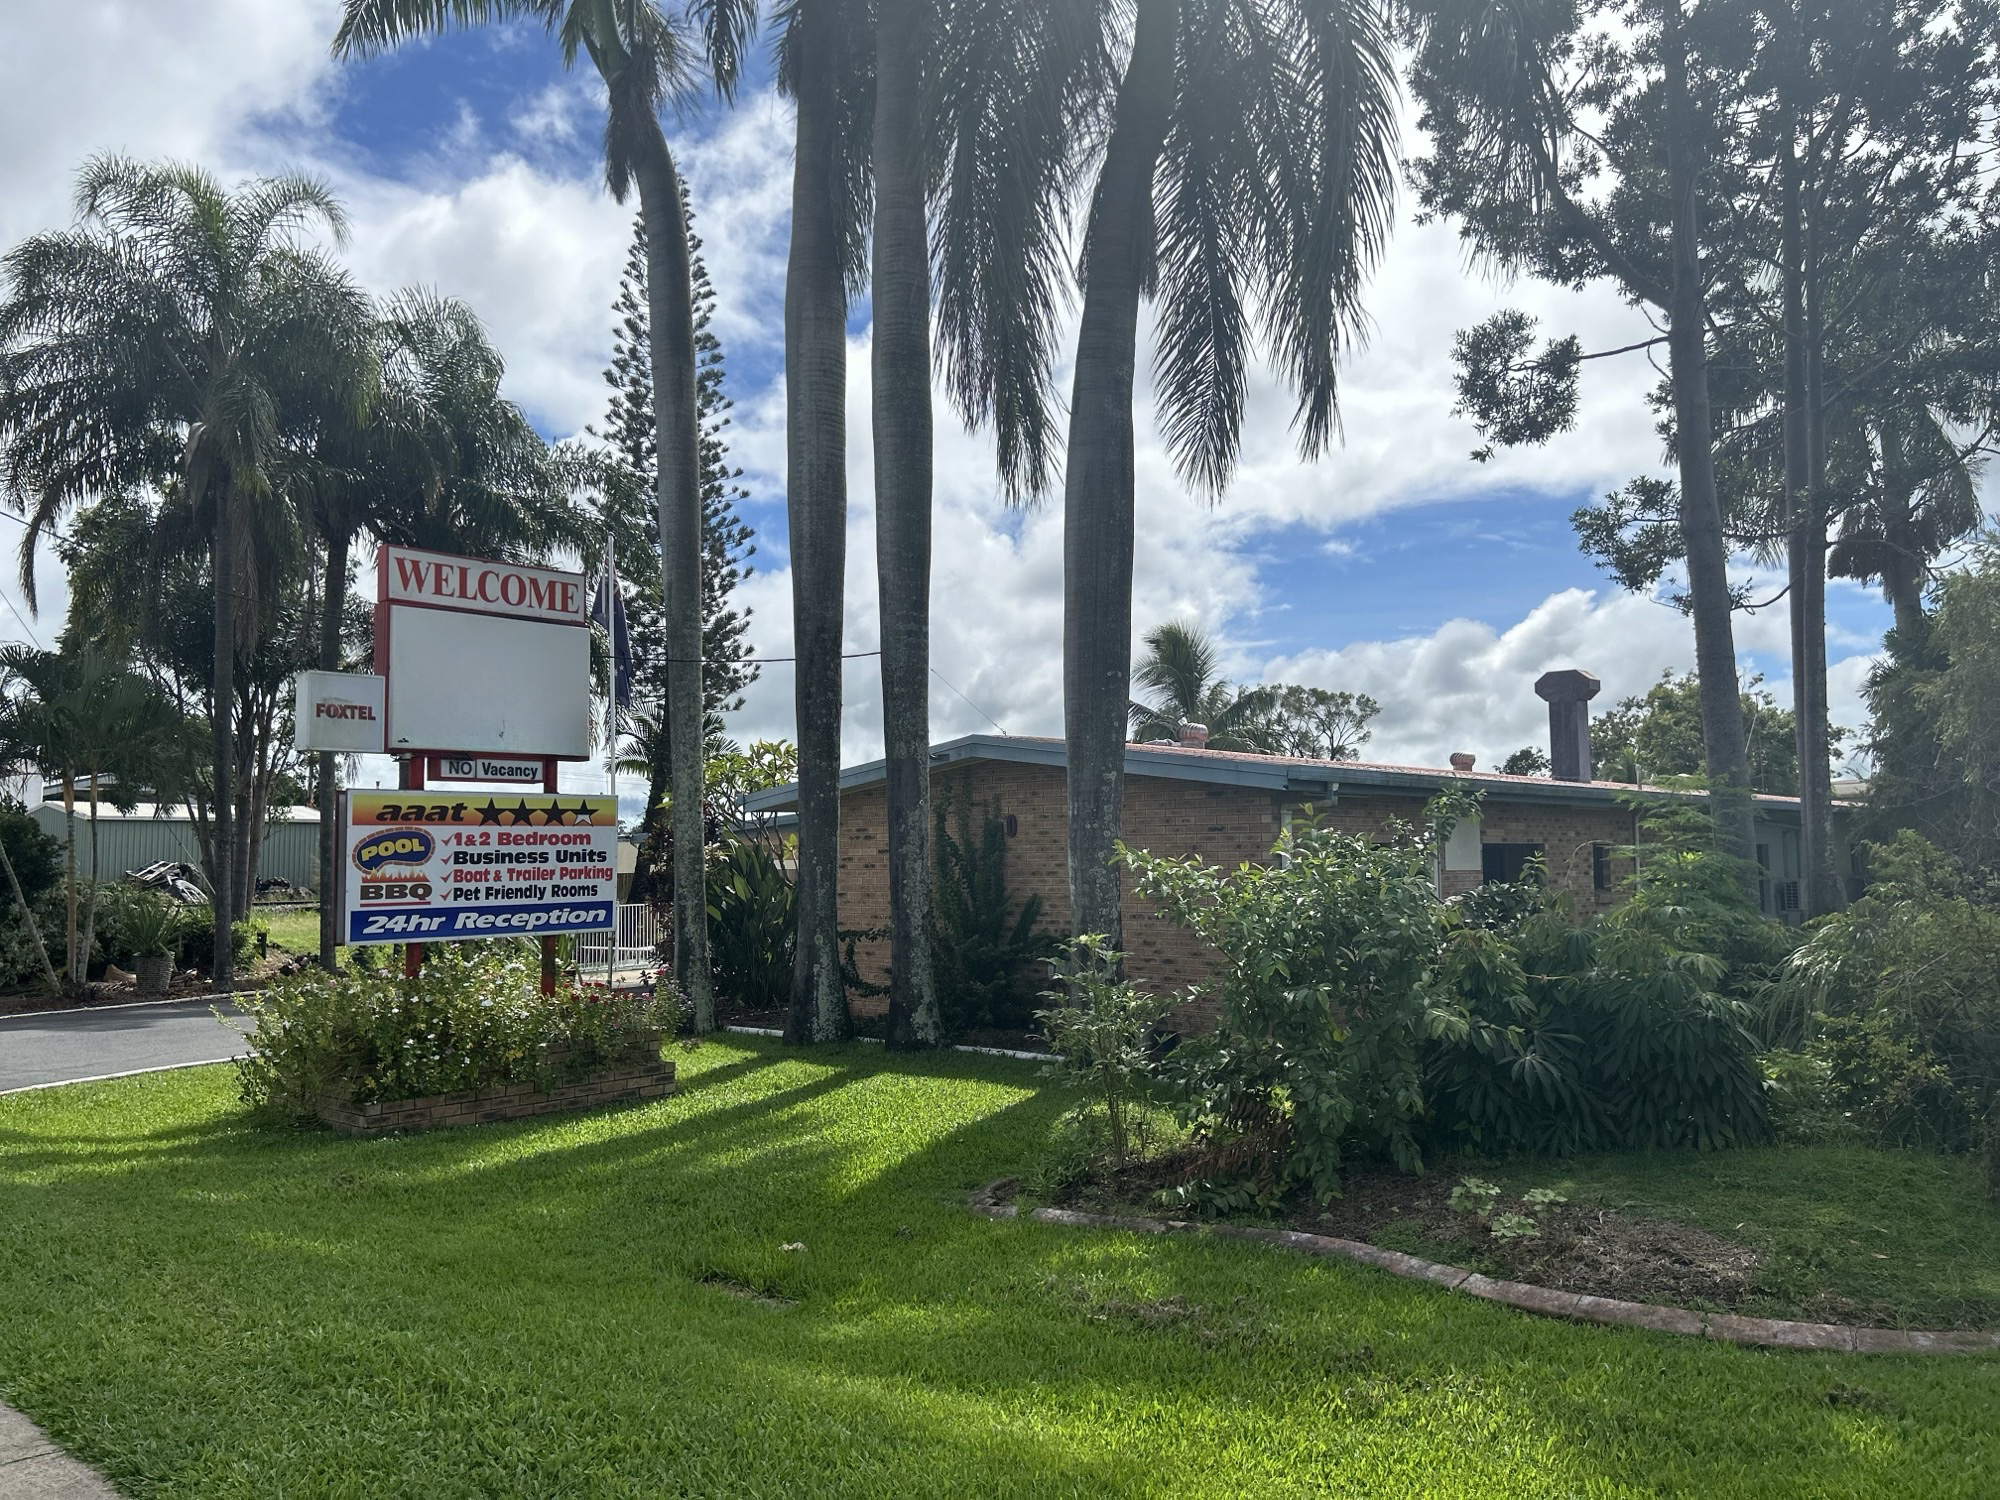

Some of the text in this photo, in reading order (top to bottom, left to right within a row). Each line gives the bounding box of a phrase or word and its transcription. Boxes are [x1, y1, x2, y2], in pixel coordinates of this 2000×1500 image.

[394, 556, 580, 614] WELCOME
[316, 703, 376, 721] FOXTEL
[448, 760, 538, 780] NO Vacancy
[376, 802, 467, 822] aaat
[497, 832, 591, 846] Bedroom
[361, 838, 425, 862] POOL
[453, 849, 607, 865] Business Units
[453, 866, 613, 883] Boat & Trailer Parking
[360, 884, 433, 901] BBQ
[453, 884, 598, 901] Pet Friendly Rooms
[362, 908, 607, 934] 24hr Reception
